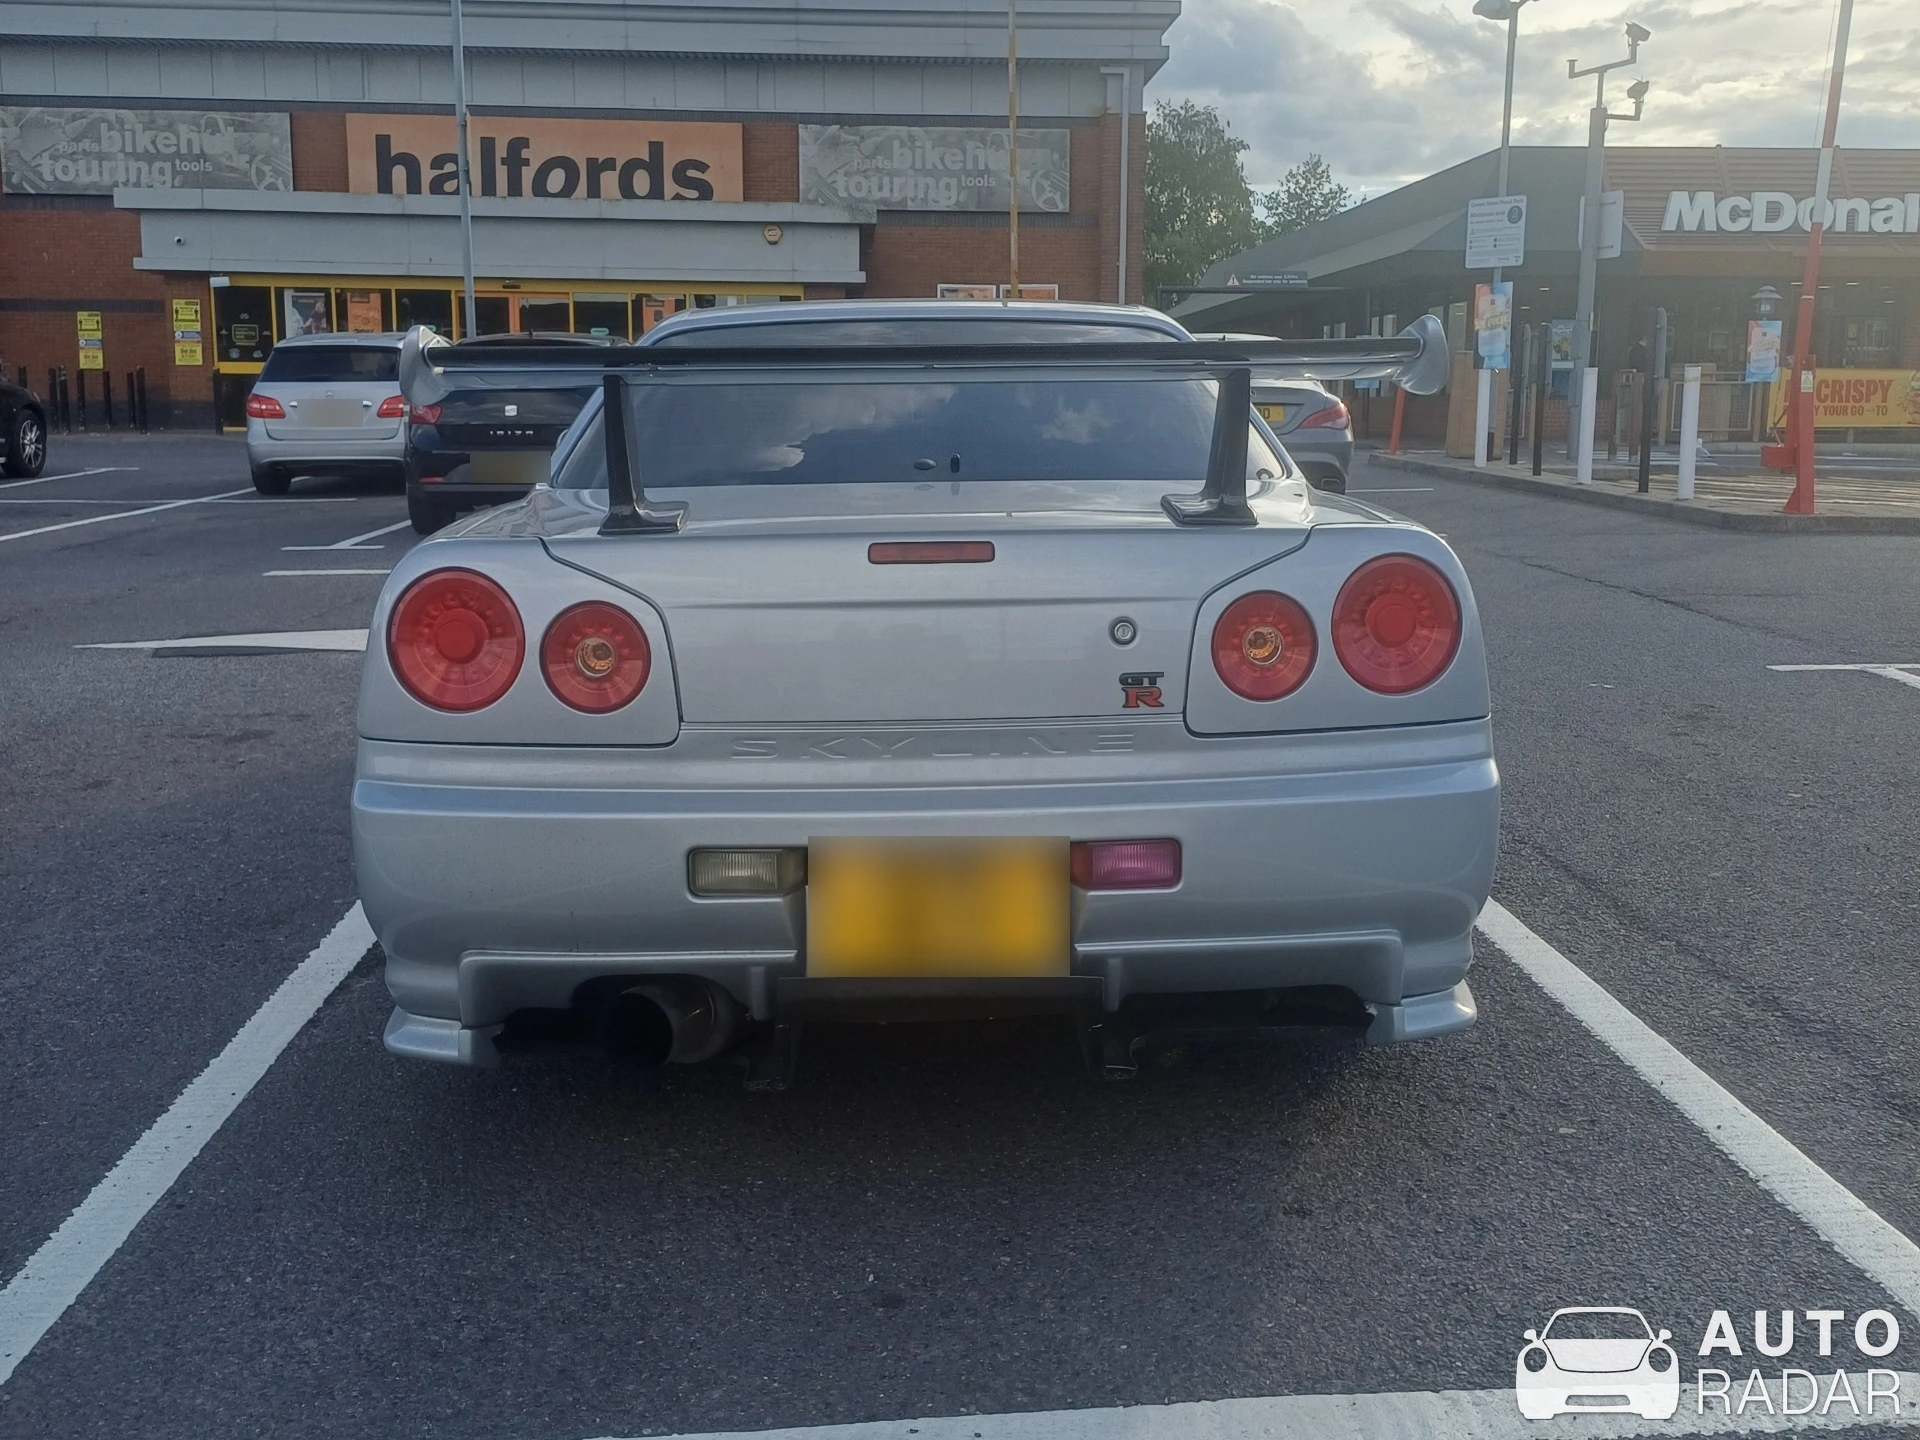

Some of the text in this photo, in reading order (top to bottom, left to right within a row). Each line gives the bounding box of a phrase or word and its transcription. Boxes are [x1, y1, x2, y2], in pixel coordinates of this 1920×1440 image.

[41, 152, 213, 188] touring tools
[375, 134, 714, 200] halfords
[836, 168, 997, 206] touring tools
[1823, 405, 1848, 416] YOUR
[1850, 405, 1865, 416] GO
[1876, 404, 1888, 416] TO
[732, 733, 1134, 759] SKYLINE
